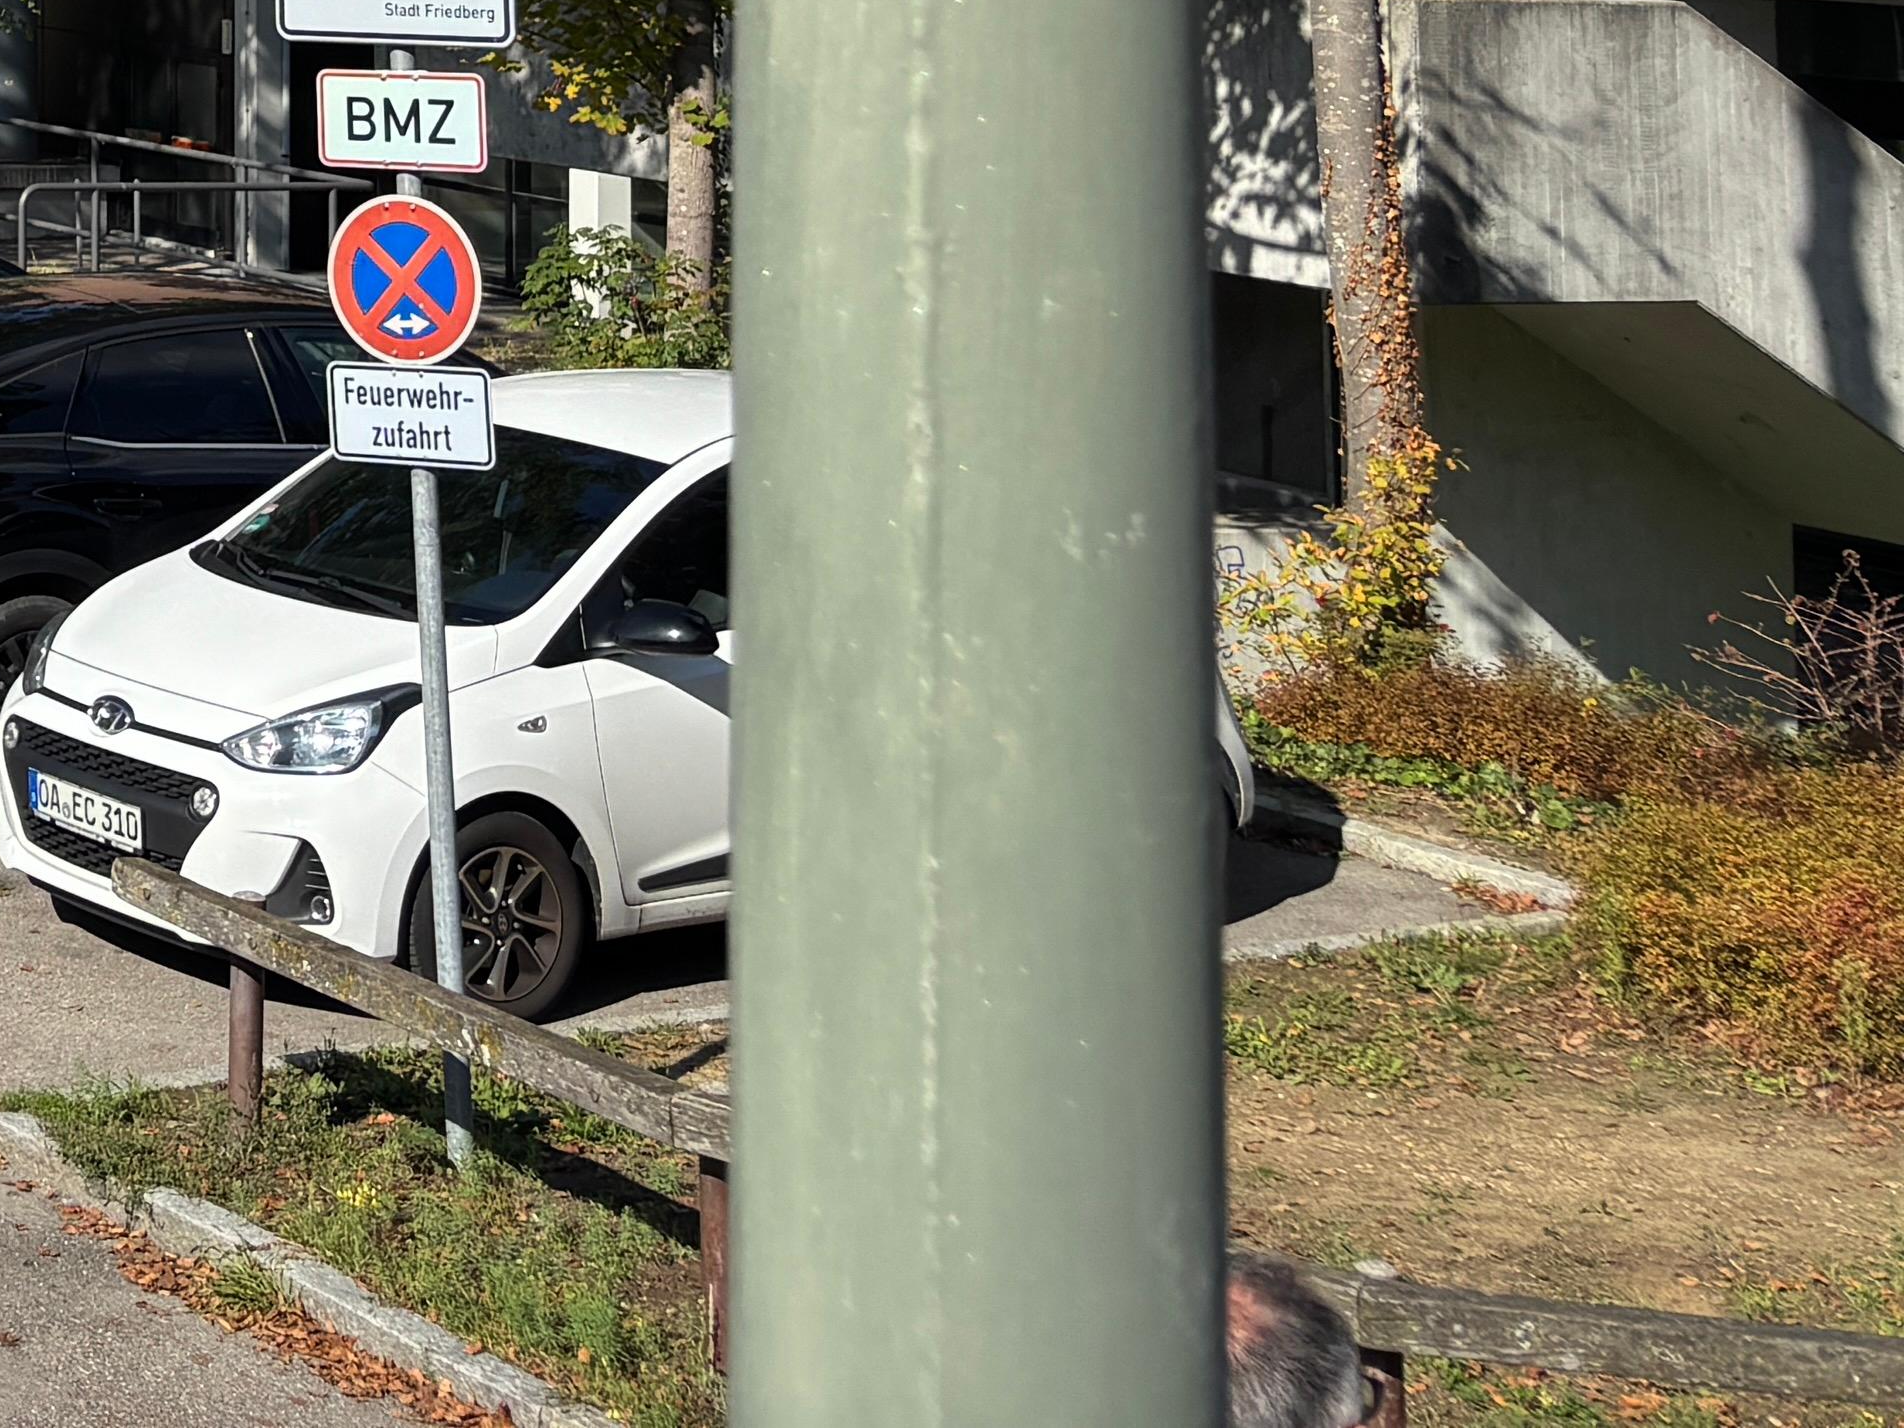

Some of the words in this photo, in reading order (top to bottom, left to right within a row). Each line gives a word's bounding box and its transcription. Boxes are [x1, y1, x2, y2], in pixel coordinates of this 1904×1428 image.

[384, 2, 421, 18] Stadt
[425, 3, 495, 23] Friedberg
[346, 96, 456, 145] BMZ
[343, 376, 474, 411] Feuerwehr-
[372, 420, 452, 452] zufahrt
[72, 791, 96, 826] EC
[101, 802, 138, 842] 310
